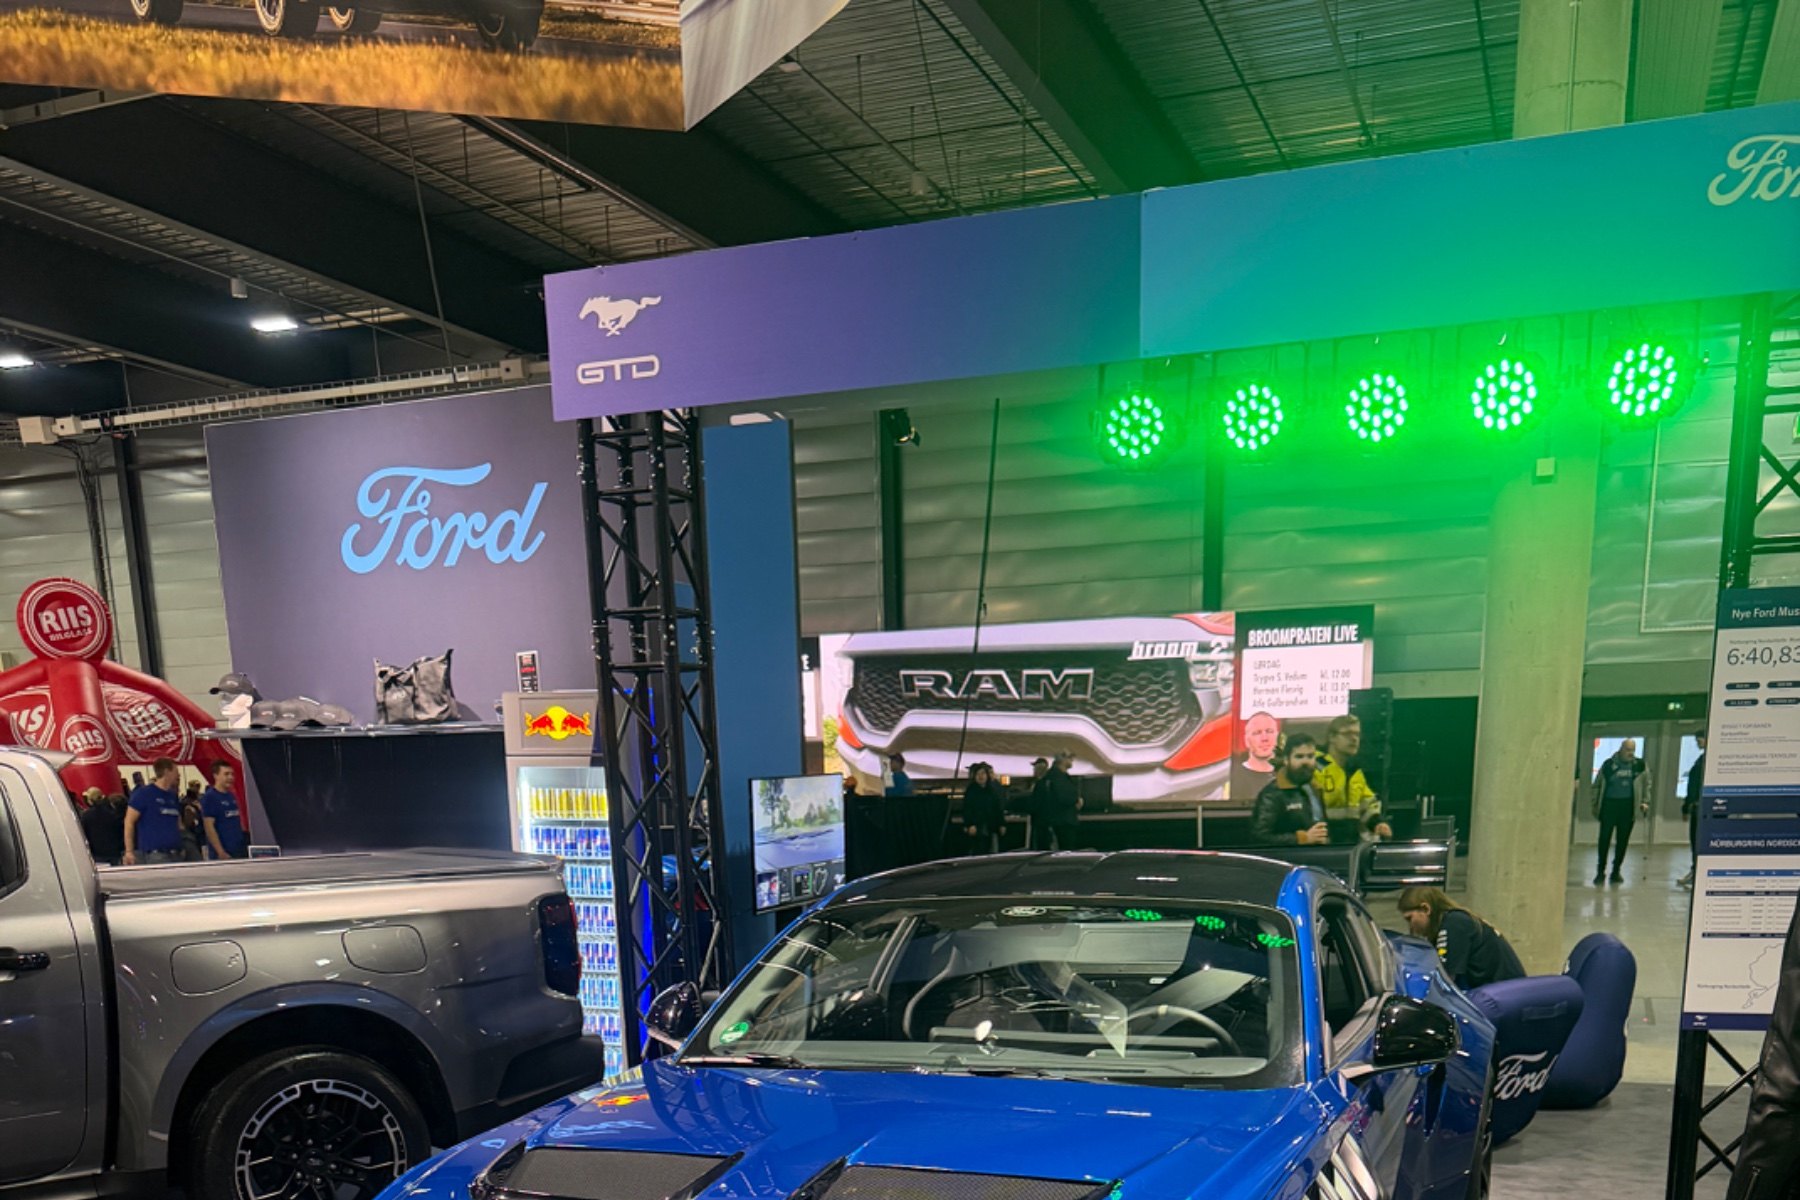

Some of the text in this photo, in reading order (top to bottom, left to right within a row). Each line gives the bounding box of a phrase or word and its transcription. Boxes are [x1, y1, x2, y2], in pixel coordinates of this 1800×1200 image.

[1707, 134, 1800, 206] Fo
[577, 355, 660, 384] GTD
[340, 462, 549, 574] Ford
[38, 605, 92, 634] RIIS
[1732, 608, 1752, 620] Nye
[1753, 607, 1777, 618] Ford
[1127, 640, 1199, 660] broom
[1248, 624, 1359, 647] BROOMPRATEN LIVE
[899, 668, 1094, 701] RAM
[67, 729, 104, 753] RIIS
[1493, 1050, 1559, 1100] Ford
